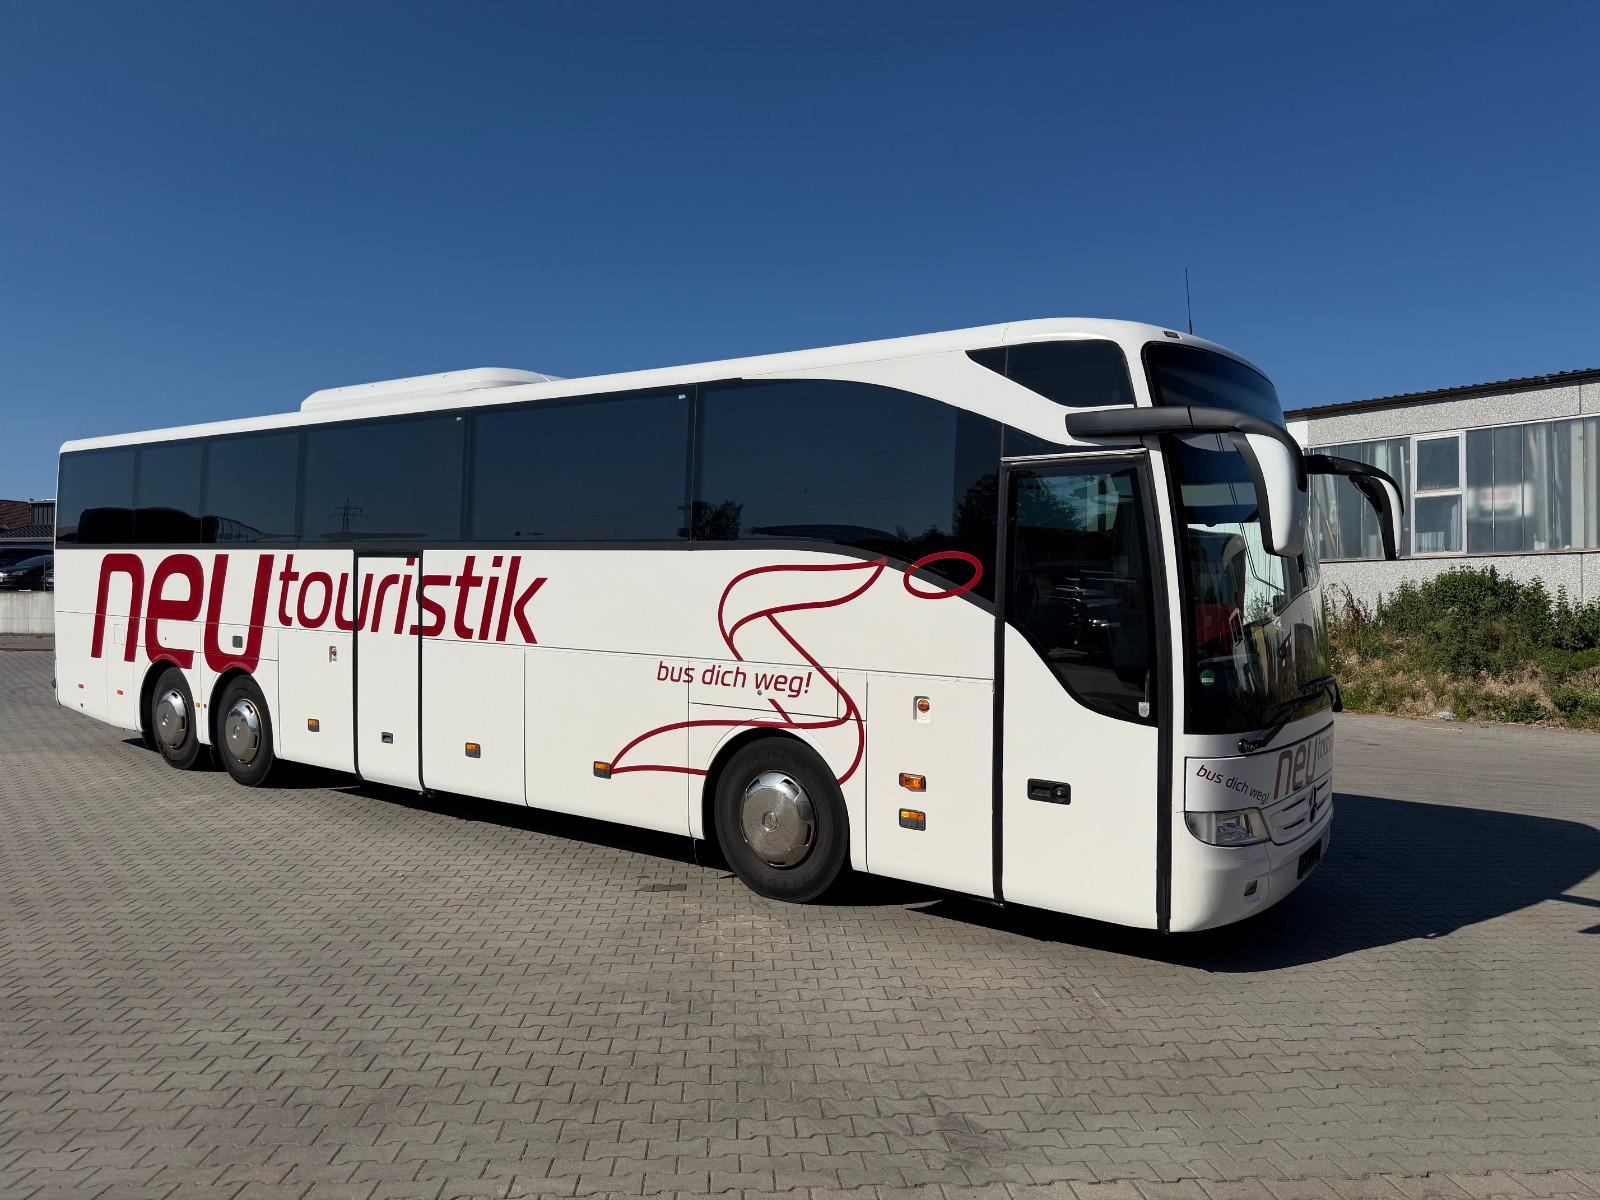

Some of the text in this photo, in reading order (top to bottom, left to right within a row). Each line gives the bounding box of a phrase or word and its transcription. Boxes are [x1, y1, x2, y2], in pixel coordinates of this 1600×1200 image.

[91, 553, 548, 673] neu touristik
[656, 661, 813, 698] bus dich weg!
[1196, 764, 1270, 804] bus dich weg!
[1274, 738, 1318, 799] neu
